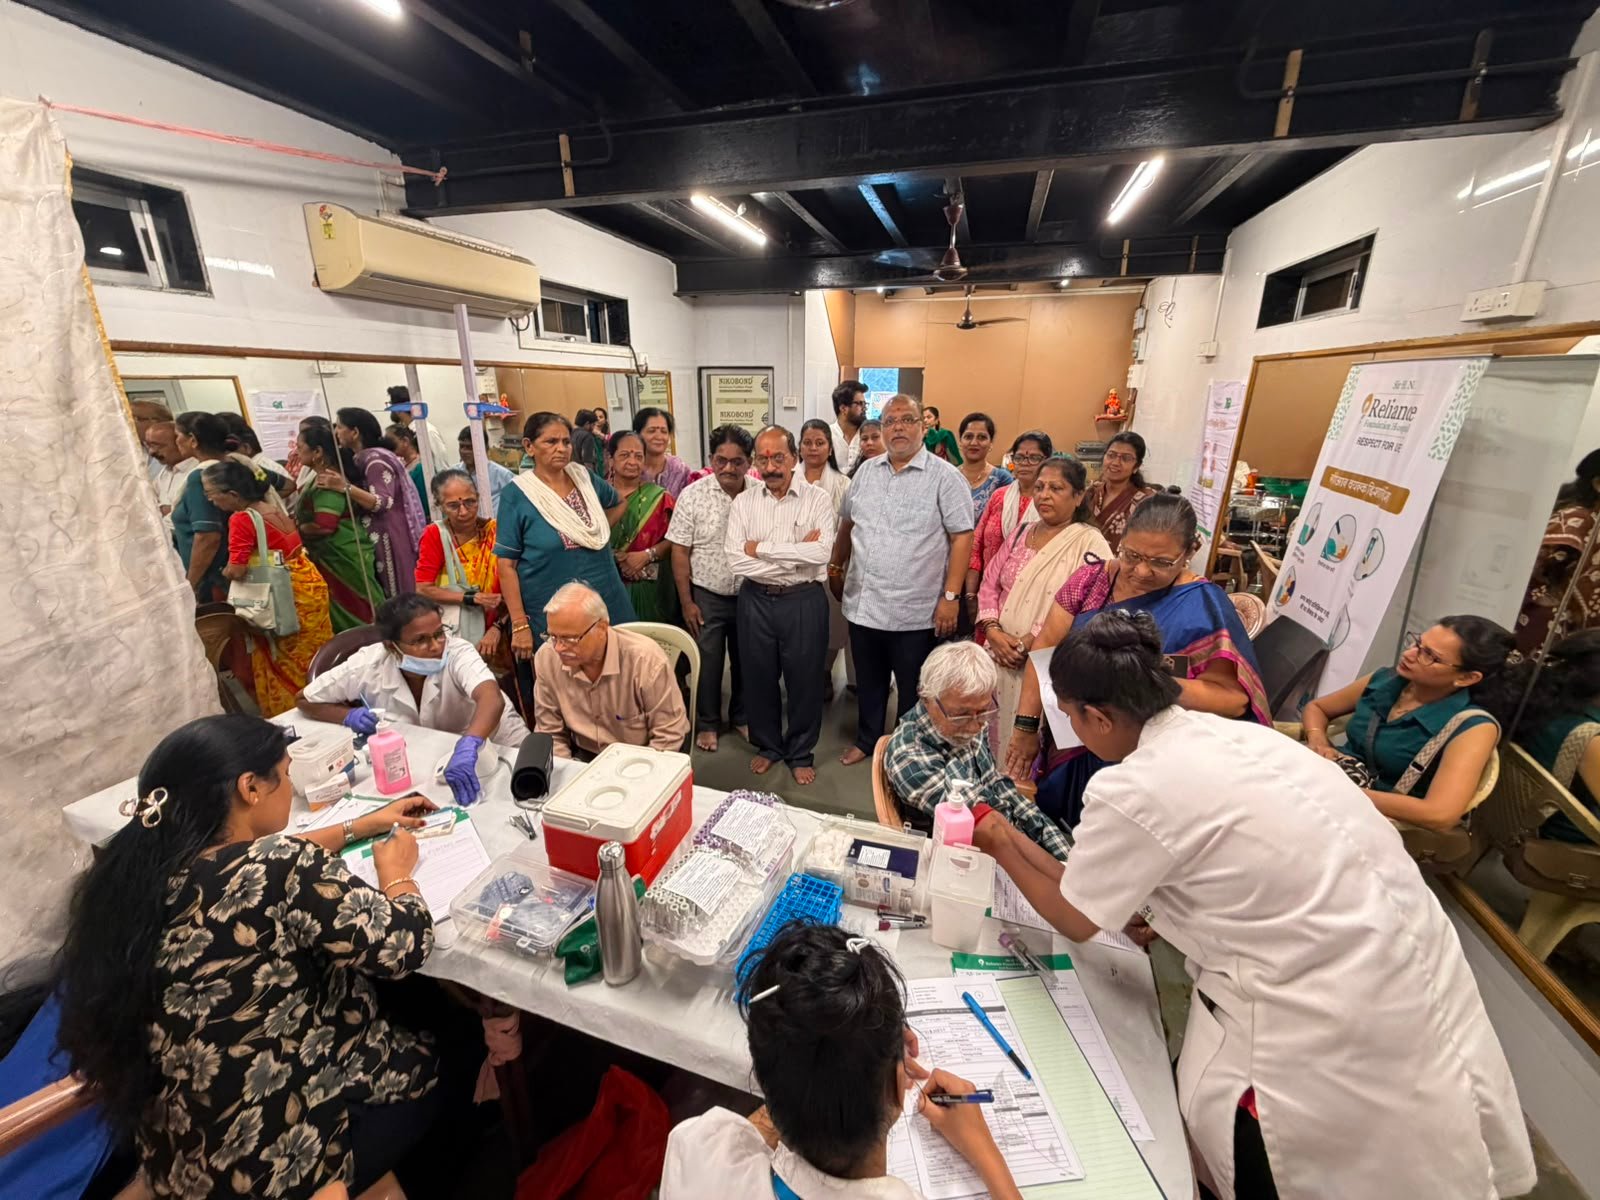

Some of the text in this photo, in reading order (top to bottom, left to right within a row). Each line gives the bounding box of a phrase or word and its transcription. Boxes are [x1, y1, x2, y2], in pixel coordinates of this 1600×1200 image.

[718, 377, 753, 385] NIKOBOND
[1369, 399, 1417, 422] Reliance
[1356, 436, 1382, 449] RESPECT
[1381, 440, 1395, 452] FOR
